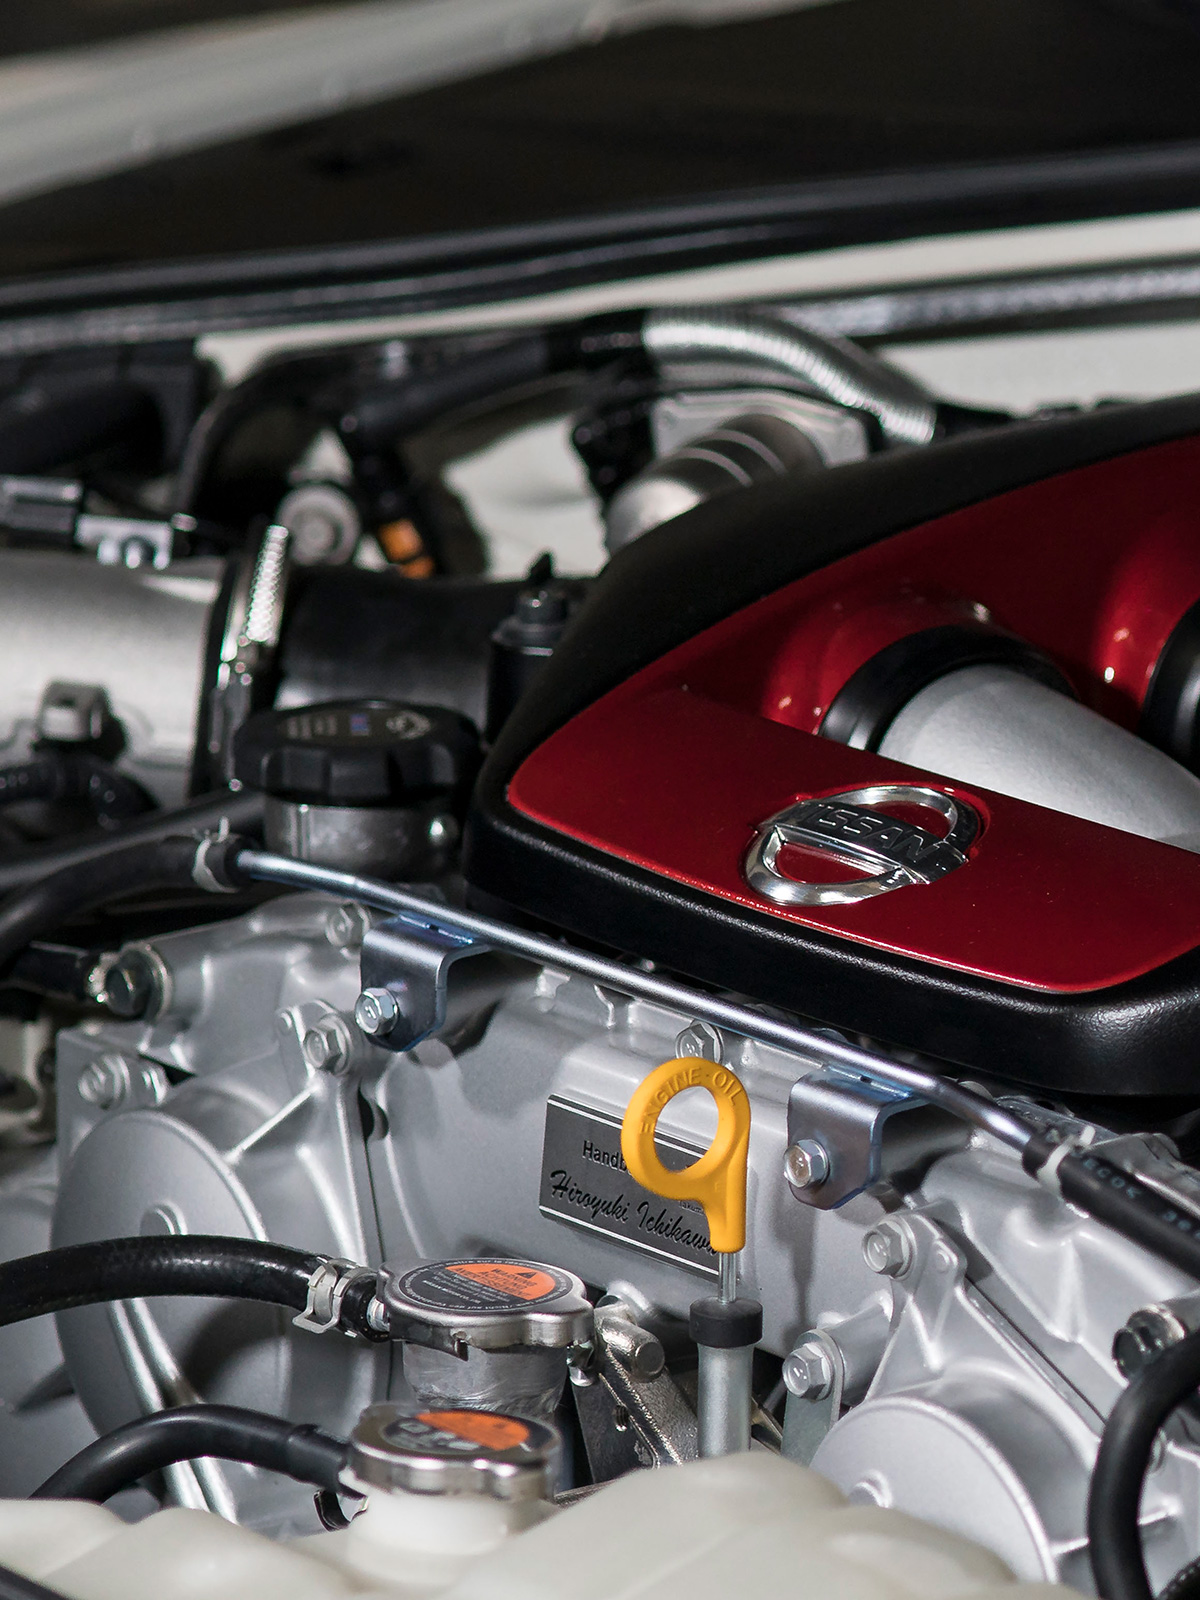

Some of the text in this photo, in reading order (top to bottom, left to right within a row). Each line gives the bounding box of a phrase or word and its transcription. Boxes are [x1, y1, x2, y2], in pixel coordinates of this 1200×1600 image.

[639, 1067, 744, 1135] ENGINE OIL
[582, 1140, 631, 1175] Handb
[550, 1169, 630, 1222] Hiroyuki
